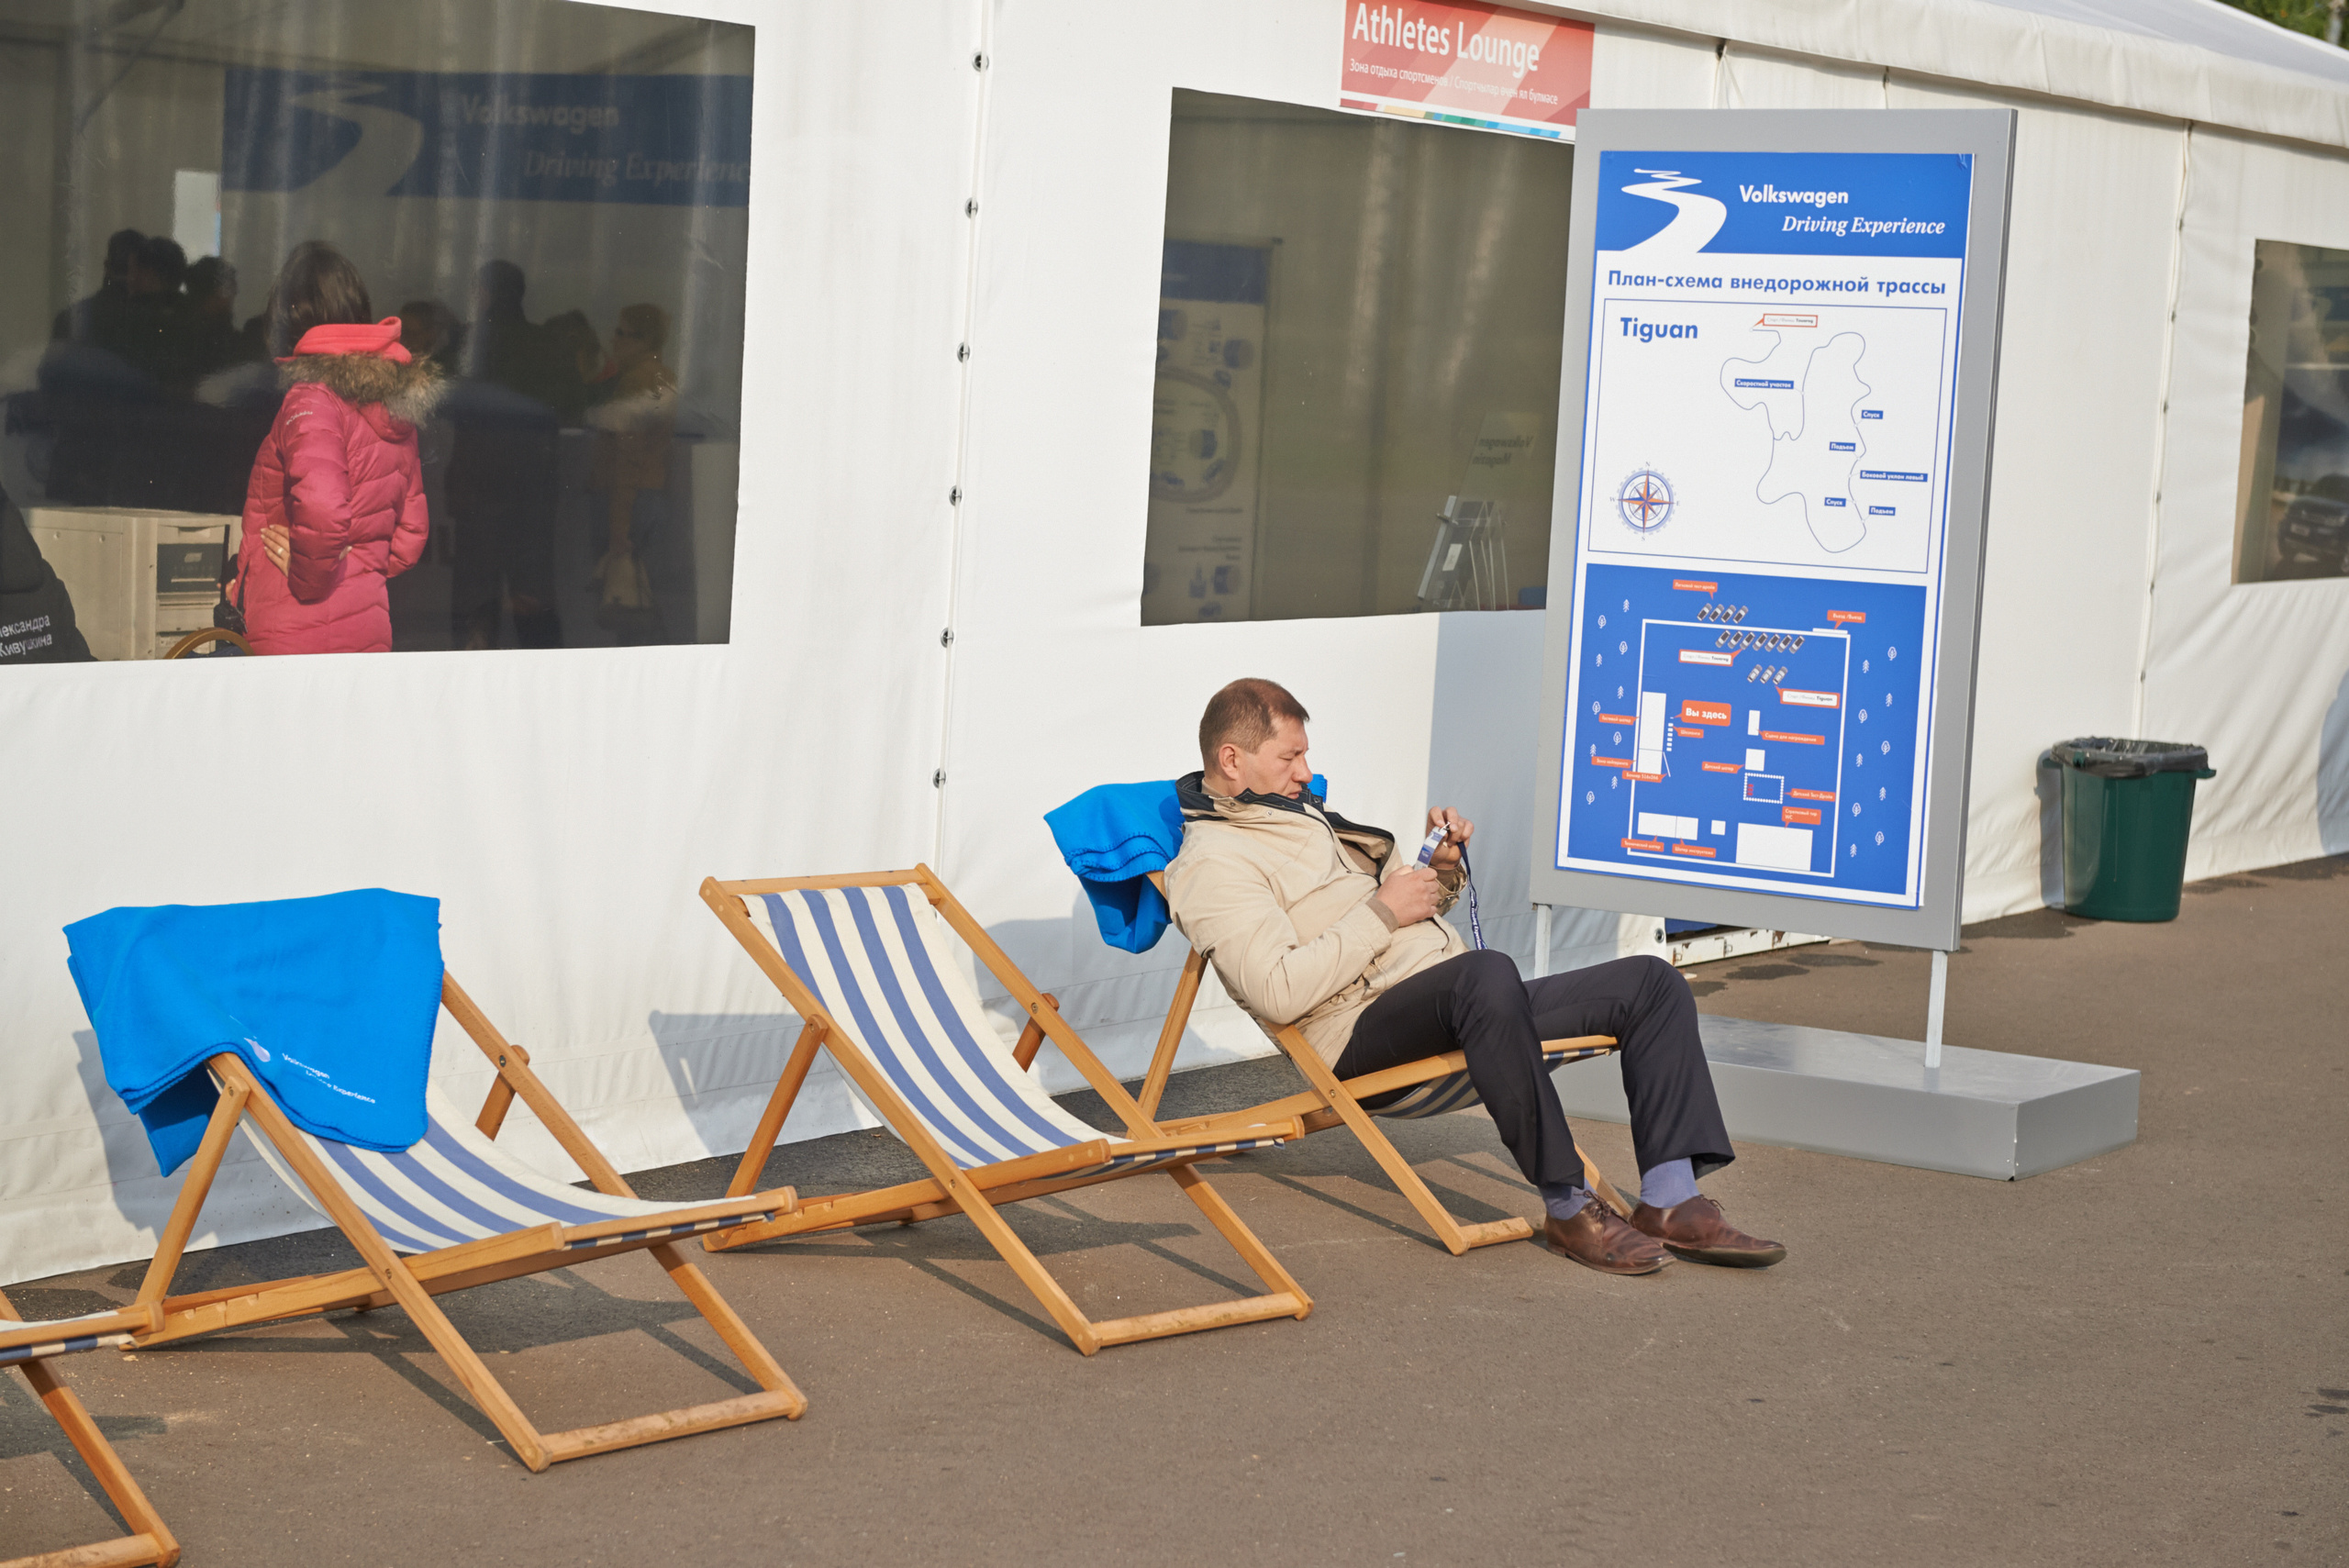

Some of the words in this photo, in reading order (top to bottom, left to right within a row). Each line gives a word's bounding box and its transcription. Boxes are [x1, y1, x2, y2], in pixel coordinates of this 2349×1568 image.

[1353, 3, 1450, 55] Athletes
[1457, 22, 1540, 78] Lounge
[1350, 58, 1368, 73] Зона
[1371, 64, 1397, 79] отдыха
[1399, 69, 1448, 86] спортсменов
[462, 95, 619, 134] Volkswagen
[625, 151, 751, 188] Experienc
[1740, 184, 1849, 207] Volkswagen
[1782, 216, 1849, 237] Driving
[1851, 217, 1945, 237] Experience
[1609, 270, 1723, 291] План-схема
[1730, 276, 1869, 295] внедорожной
[1876, 280, 1946, 296] трассы
[1620, 317, 1698, 343] Tiguan
[1736, 379, 1768, 388] Скоростной
[1863, 410, 1880, 419] Спуск
[1862, 471, 1887, 480] Боковой
[1826, 498, 1842, 506] Спуск
[1685, 707, 1699, 717] Вы
[1701, 710, 1727, 719] здесь
